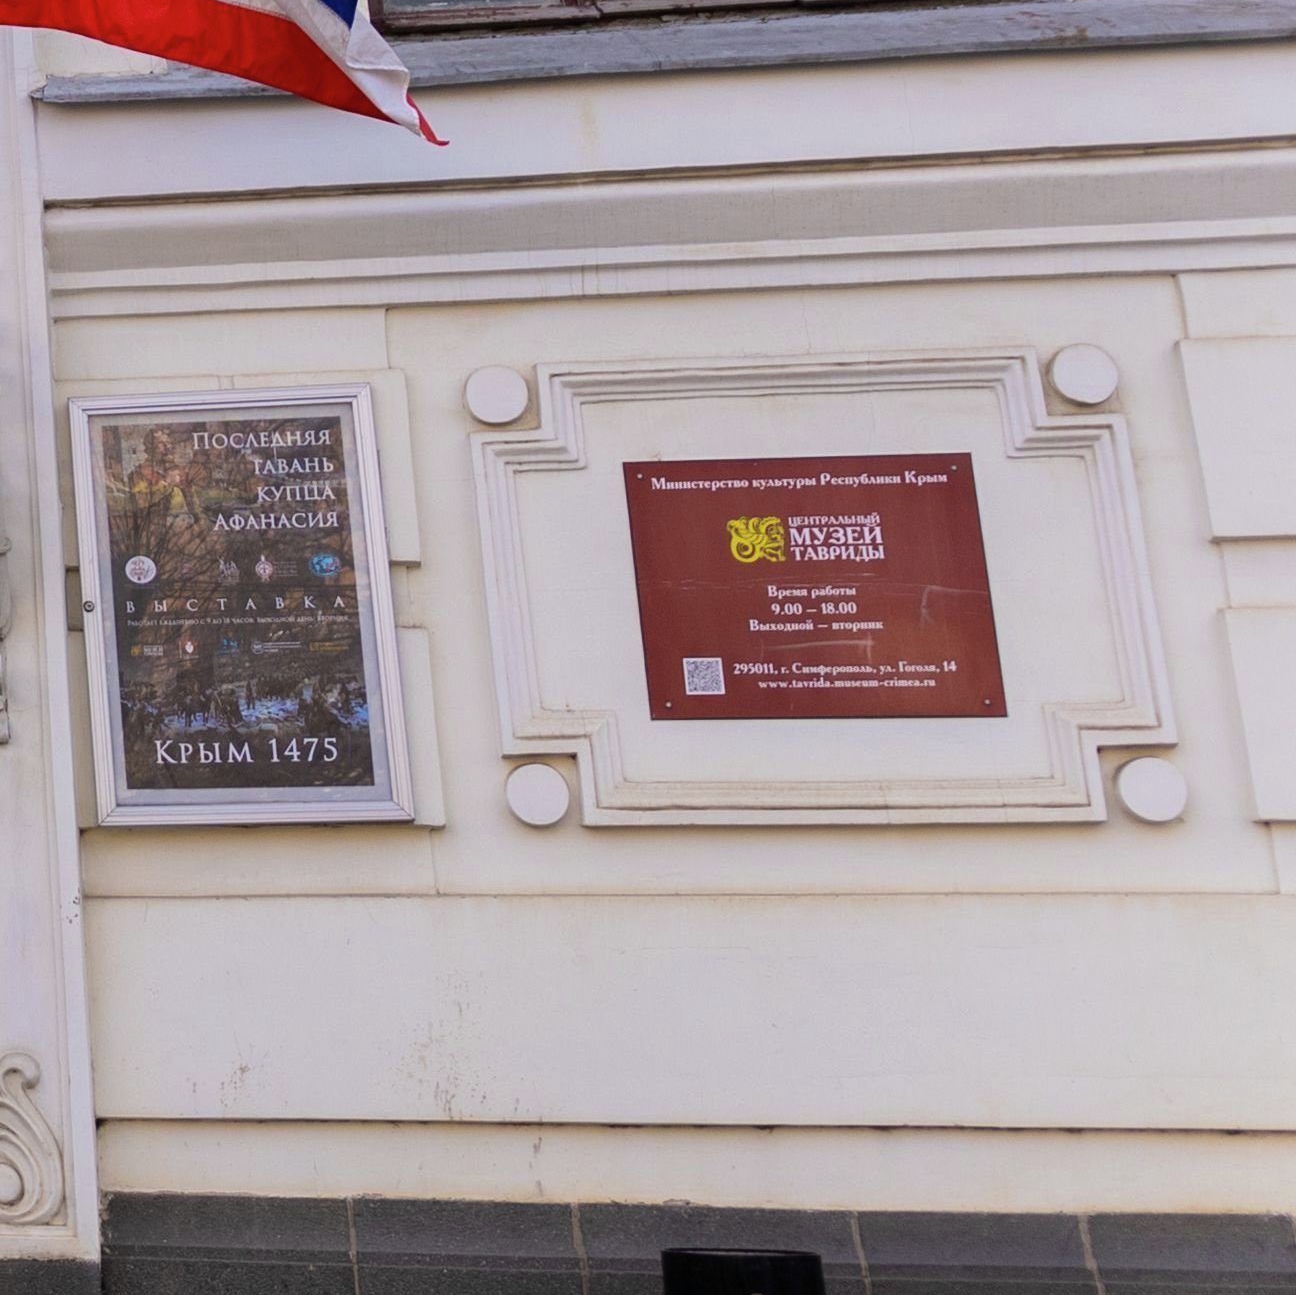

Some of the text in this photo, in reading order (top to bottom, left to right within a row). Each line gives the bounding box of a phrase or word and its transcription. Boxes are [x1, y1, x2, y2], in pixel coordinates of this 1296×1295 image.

[192, 429, 332, 450] ПОСЛЕДНЯЯ
[253, 457, 334, 475] ГАВАНЬ
[651, 470, 948, 491] Министерство культуры Республики Крым
[257, 484, 336, 502] КУПЦА
[213, 511, 339, 531] АФАНАСИЯ
[788, 512, 880, 527] ЦЕНТРАЛЬНЫЙ
[789, 525, 883, 545] МУЗЕЙ
[790, 545, 885, 562] ТАВРИДЫ
[768, 585, 857, 599] Время работы
[771, 602, 803, 615] 9.00
[821, 602, 858, 615] 18.00
[749, 619, 814, 632] Выходной
[832, 621, 884, 633] вторник
[733, 660, 957, 676] 295011, г. Симферополь, ул. Гоголя, 14
[758, 676, 936, 689] www.tavrida.museum-crimea.ru
[267, 738, 338, 763] 1475
